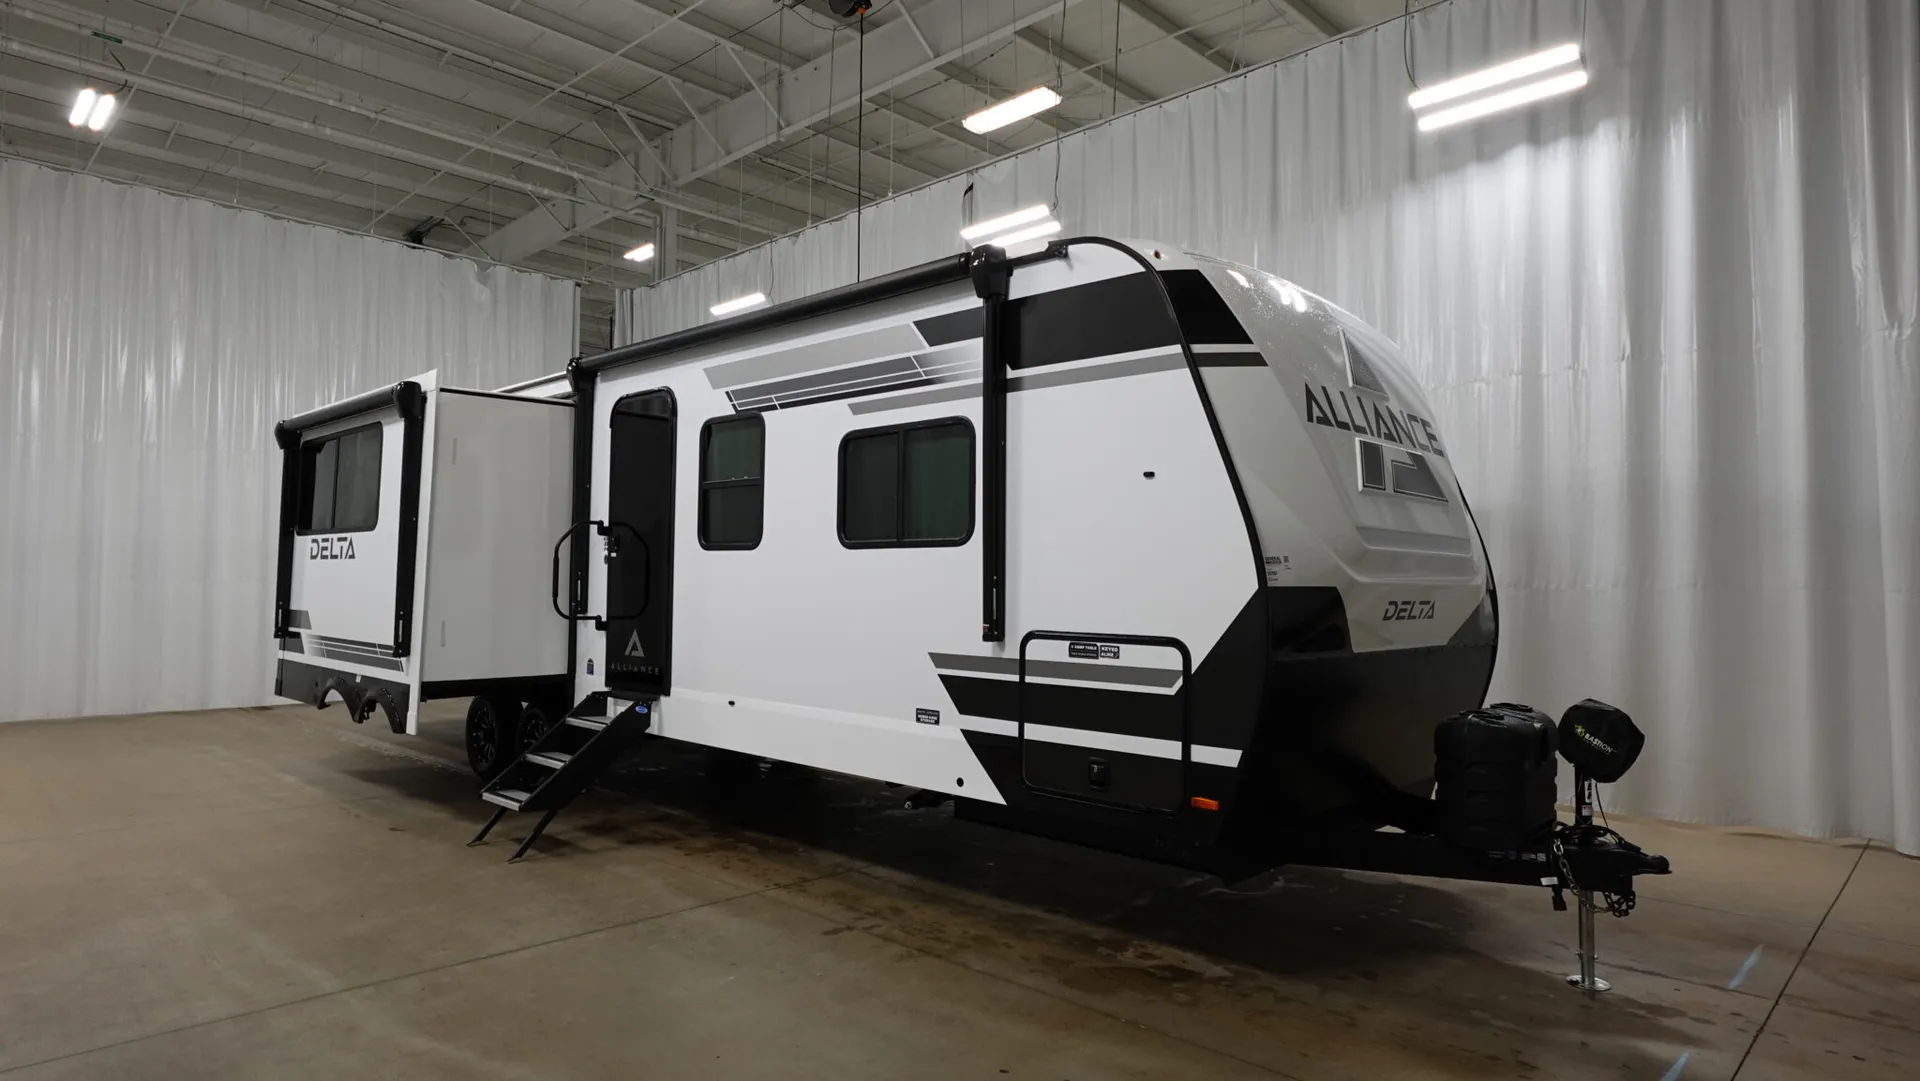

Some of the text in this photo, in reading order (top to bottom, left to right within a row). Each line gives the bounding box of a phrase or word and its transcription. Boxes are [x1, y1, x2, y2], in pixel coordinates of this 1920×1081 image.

[1304, 381, 1445, 458] ALLIANCE
[309, 536, 356, 560] DELTA
[1382, 600, 1436, 621] DELTA
[610, 661, 660, 675] ALLIANCE
[1584, 732, 1614, 753] BASTION
